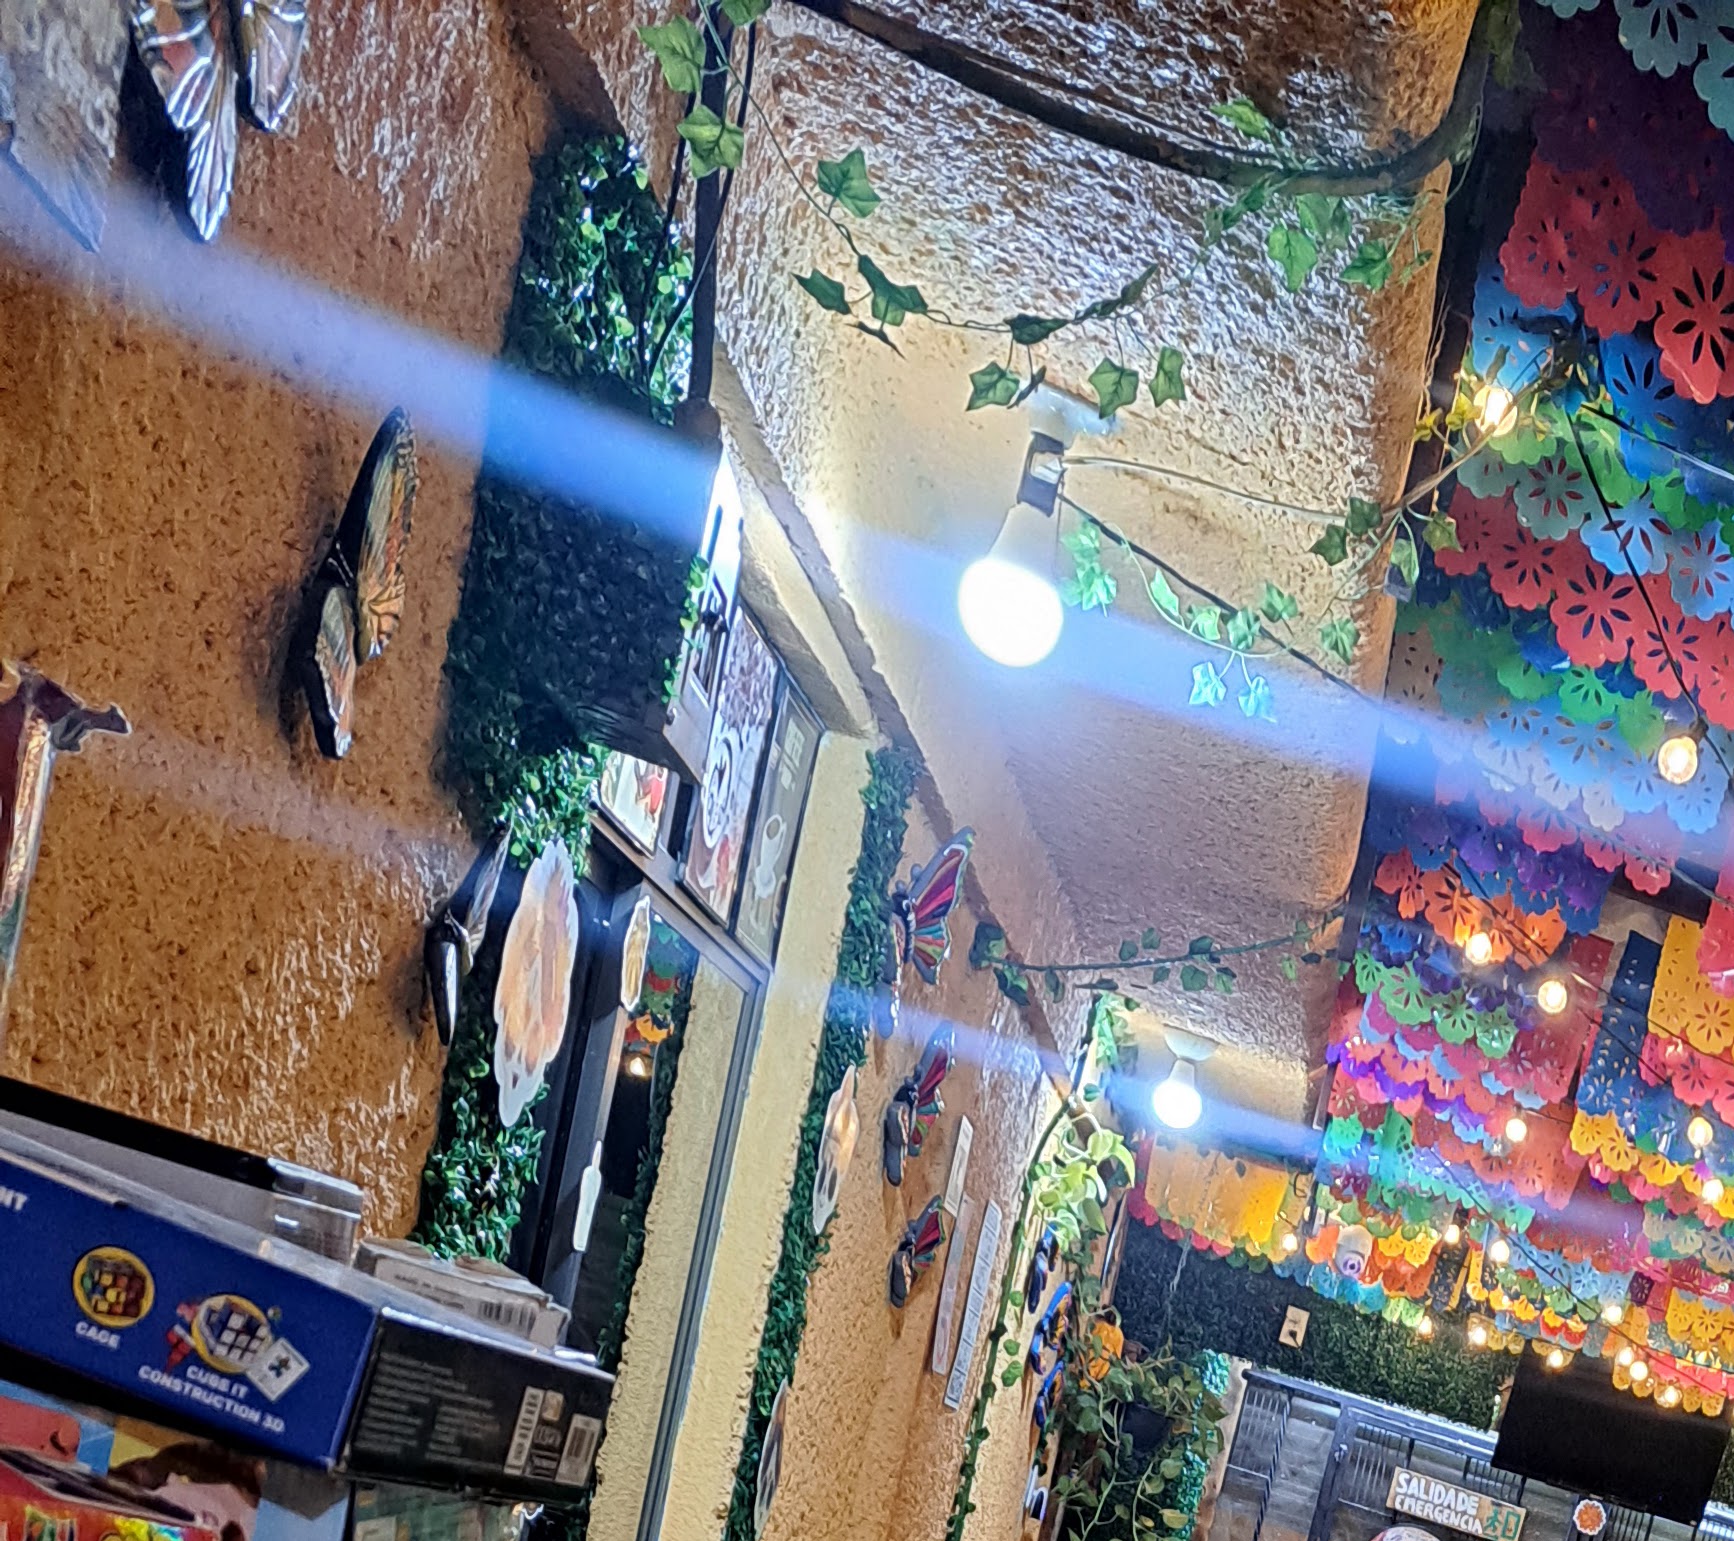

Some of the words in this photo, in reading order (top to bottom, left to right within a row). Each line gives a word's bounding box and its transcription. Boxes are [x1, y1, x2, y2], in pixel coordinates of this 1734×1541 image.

[138, 1365, 261, 1424] CONSTRUCTION
[231, 1378, 248, 1398] IT
[1394, 1494, 1484, 1535] EMERGENCIA
